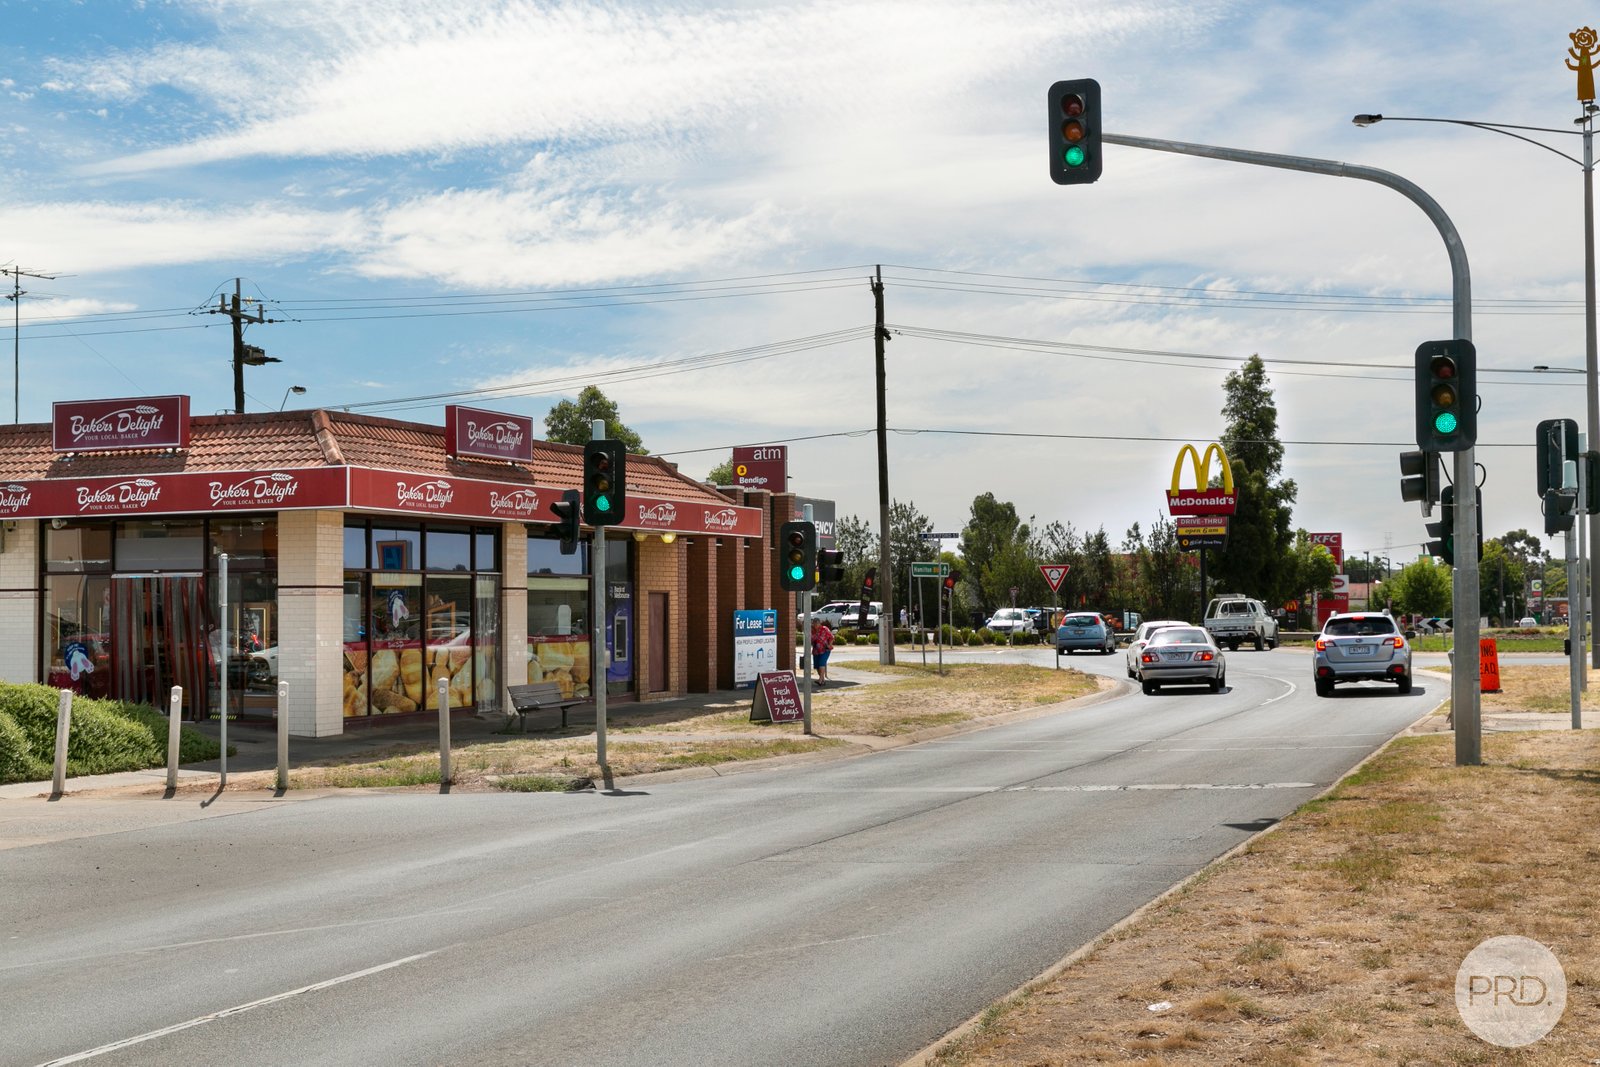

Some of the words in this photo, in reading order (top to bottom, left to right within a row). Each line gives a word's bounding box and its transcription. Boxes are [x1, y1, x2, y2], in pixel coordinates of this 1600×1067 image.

[70, 415, 113, 437] Bakers
[117, 412, 164, 437] Delight
[467, 421, 494, 442] Bakers
[496, 425, 523, 450] Delight
[753, 447, 781, 460] atm
[739, 476, 768, 485] Bendigo
[76, 486, 115, 505] Bakers
[118, 485, 161, 507] Delight
[209, 481, 250, 501] Bakers
[253, 479, 298, 503] Delight
[396, 481, 424, 501] Bakers
[426, 484, 454, 508] Delight
[490, 491, 514, 509] Bakers
[515, 493, 539, 515] Delight
[1170, 497, 1234, 506] McDonald's
[639, 504, 658, 522] Bakers
[658, 506, 677, 526] Delight
[704, 510, 720, 527] Bakers
[721, 512, 738, 531] Delight
[1313, 534, 1338, 544] KFC
[735, 617, 746, 629] For
[746, 617, 762, 629] Lease
[1480, 645, 1494, 657] ING
[773, 686, 790, 696] Fresh
[773, 697, 795, 707] Baking
[775, 707, 780, 716] 7
[781, 706, 799, 719] days
